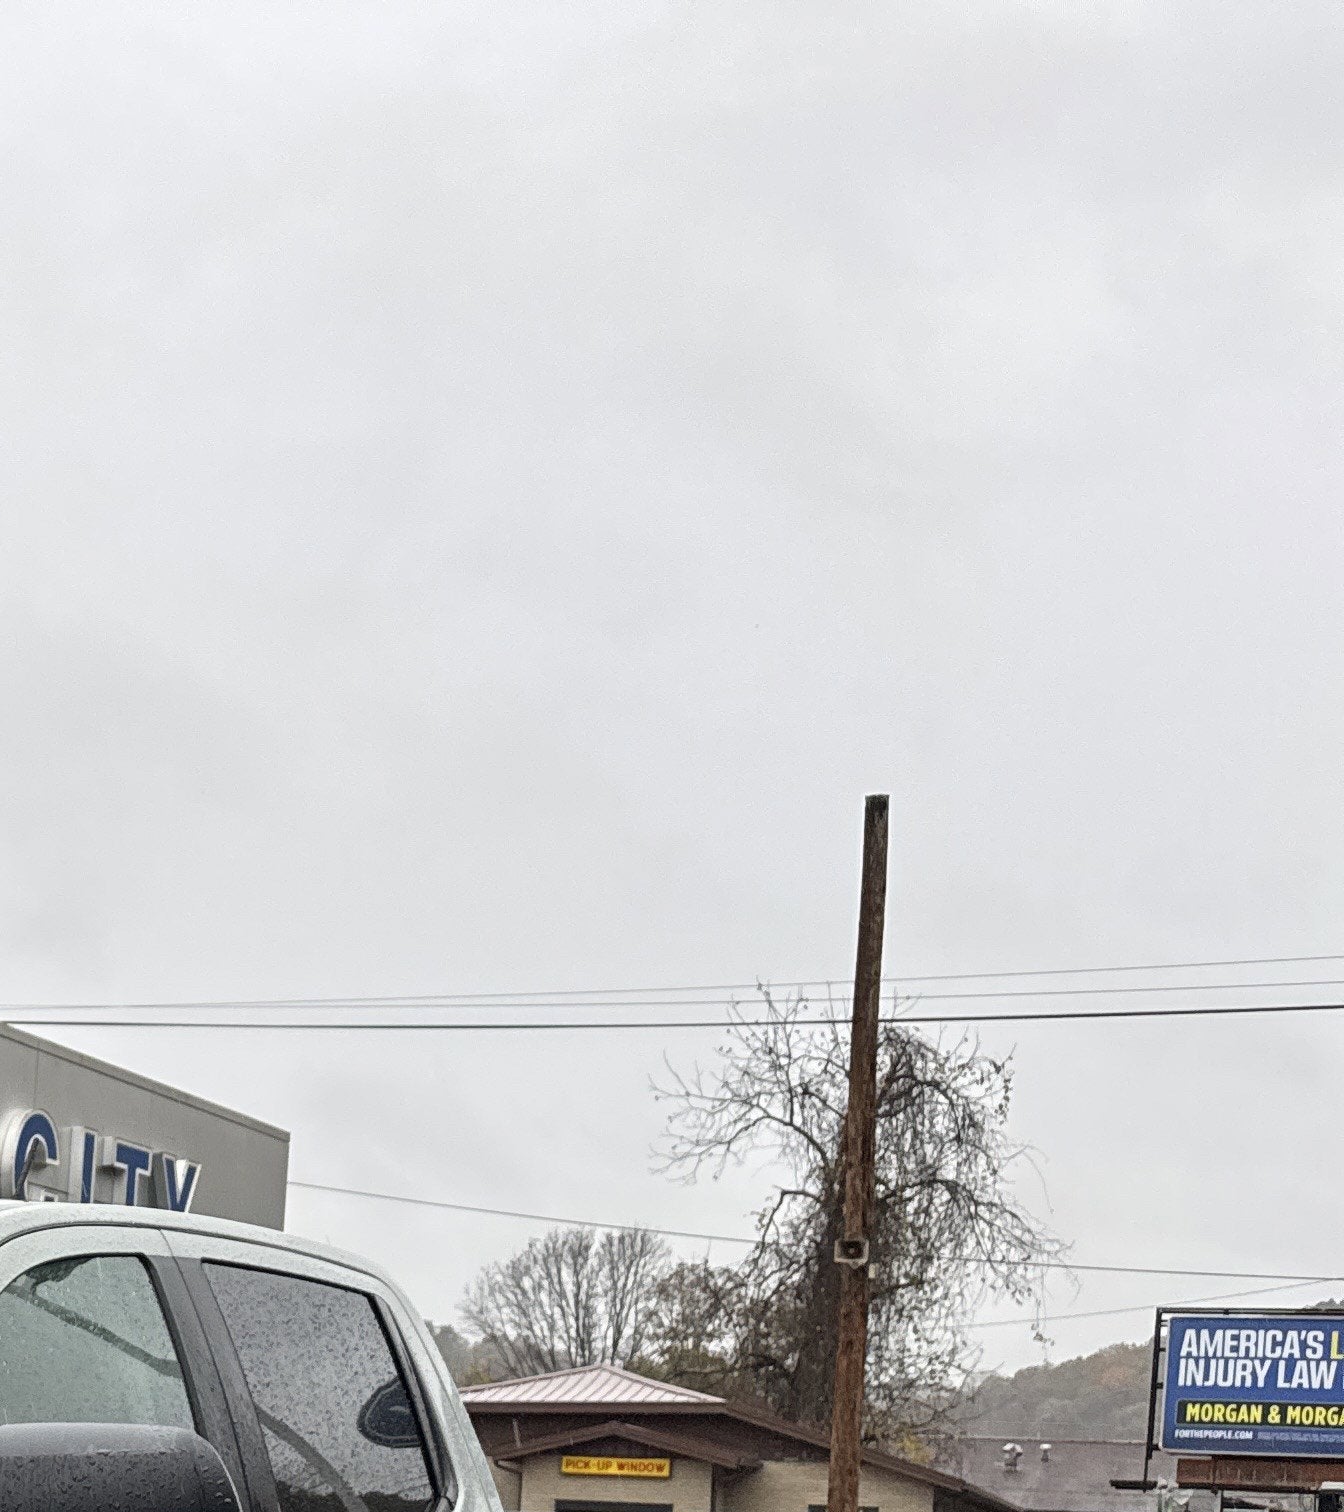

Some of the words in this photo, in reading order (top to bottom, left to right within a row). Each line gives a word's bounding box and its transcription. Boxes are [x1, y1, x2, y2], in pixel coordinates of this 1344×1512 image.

[8, 1108, 203, 1213] CITY
[1179, 1328, 1325, 1360] AMERICA'S
[1177, 1358, 1272, 1388] INJURY
[1276, 1359, 1338, 1390] LAW
[1185, 1403, 1263, 1424] MORGAN
[1267, 1404, 1282, 1424] &
[1174, 1428, 1253, 1440] FORTHEPEOPLE.COM
[617, 1461, 666, 1473] WINDOW
